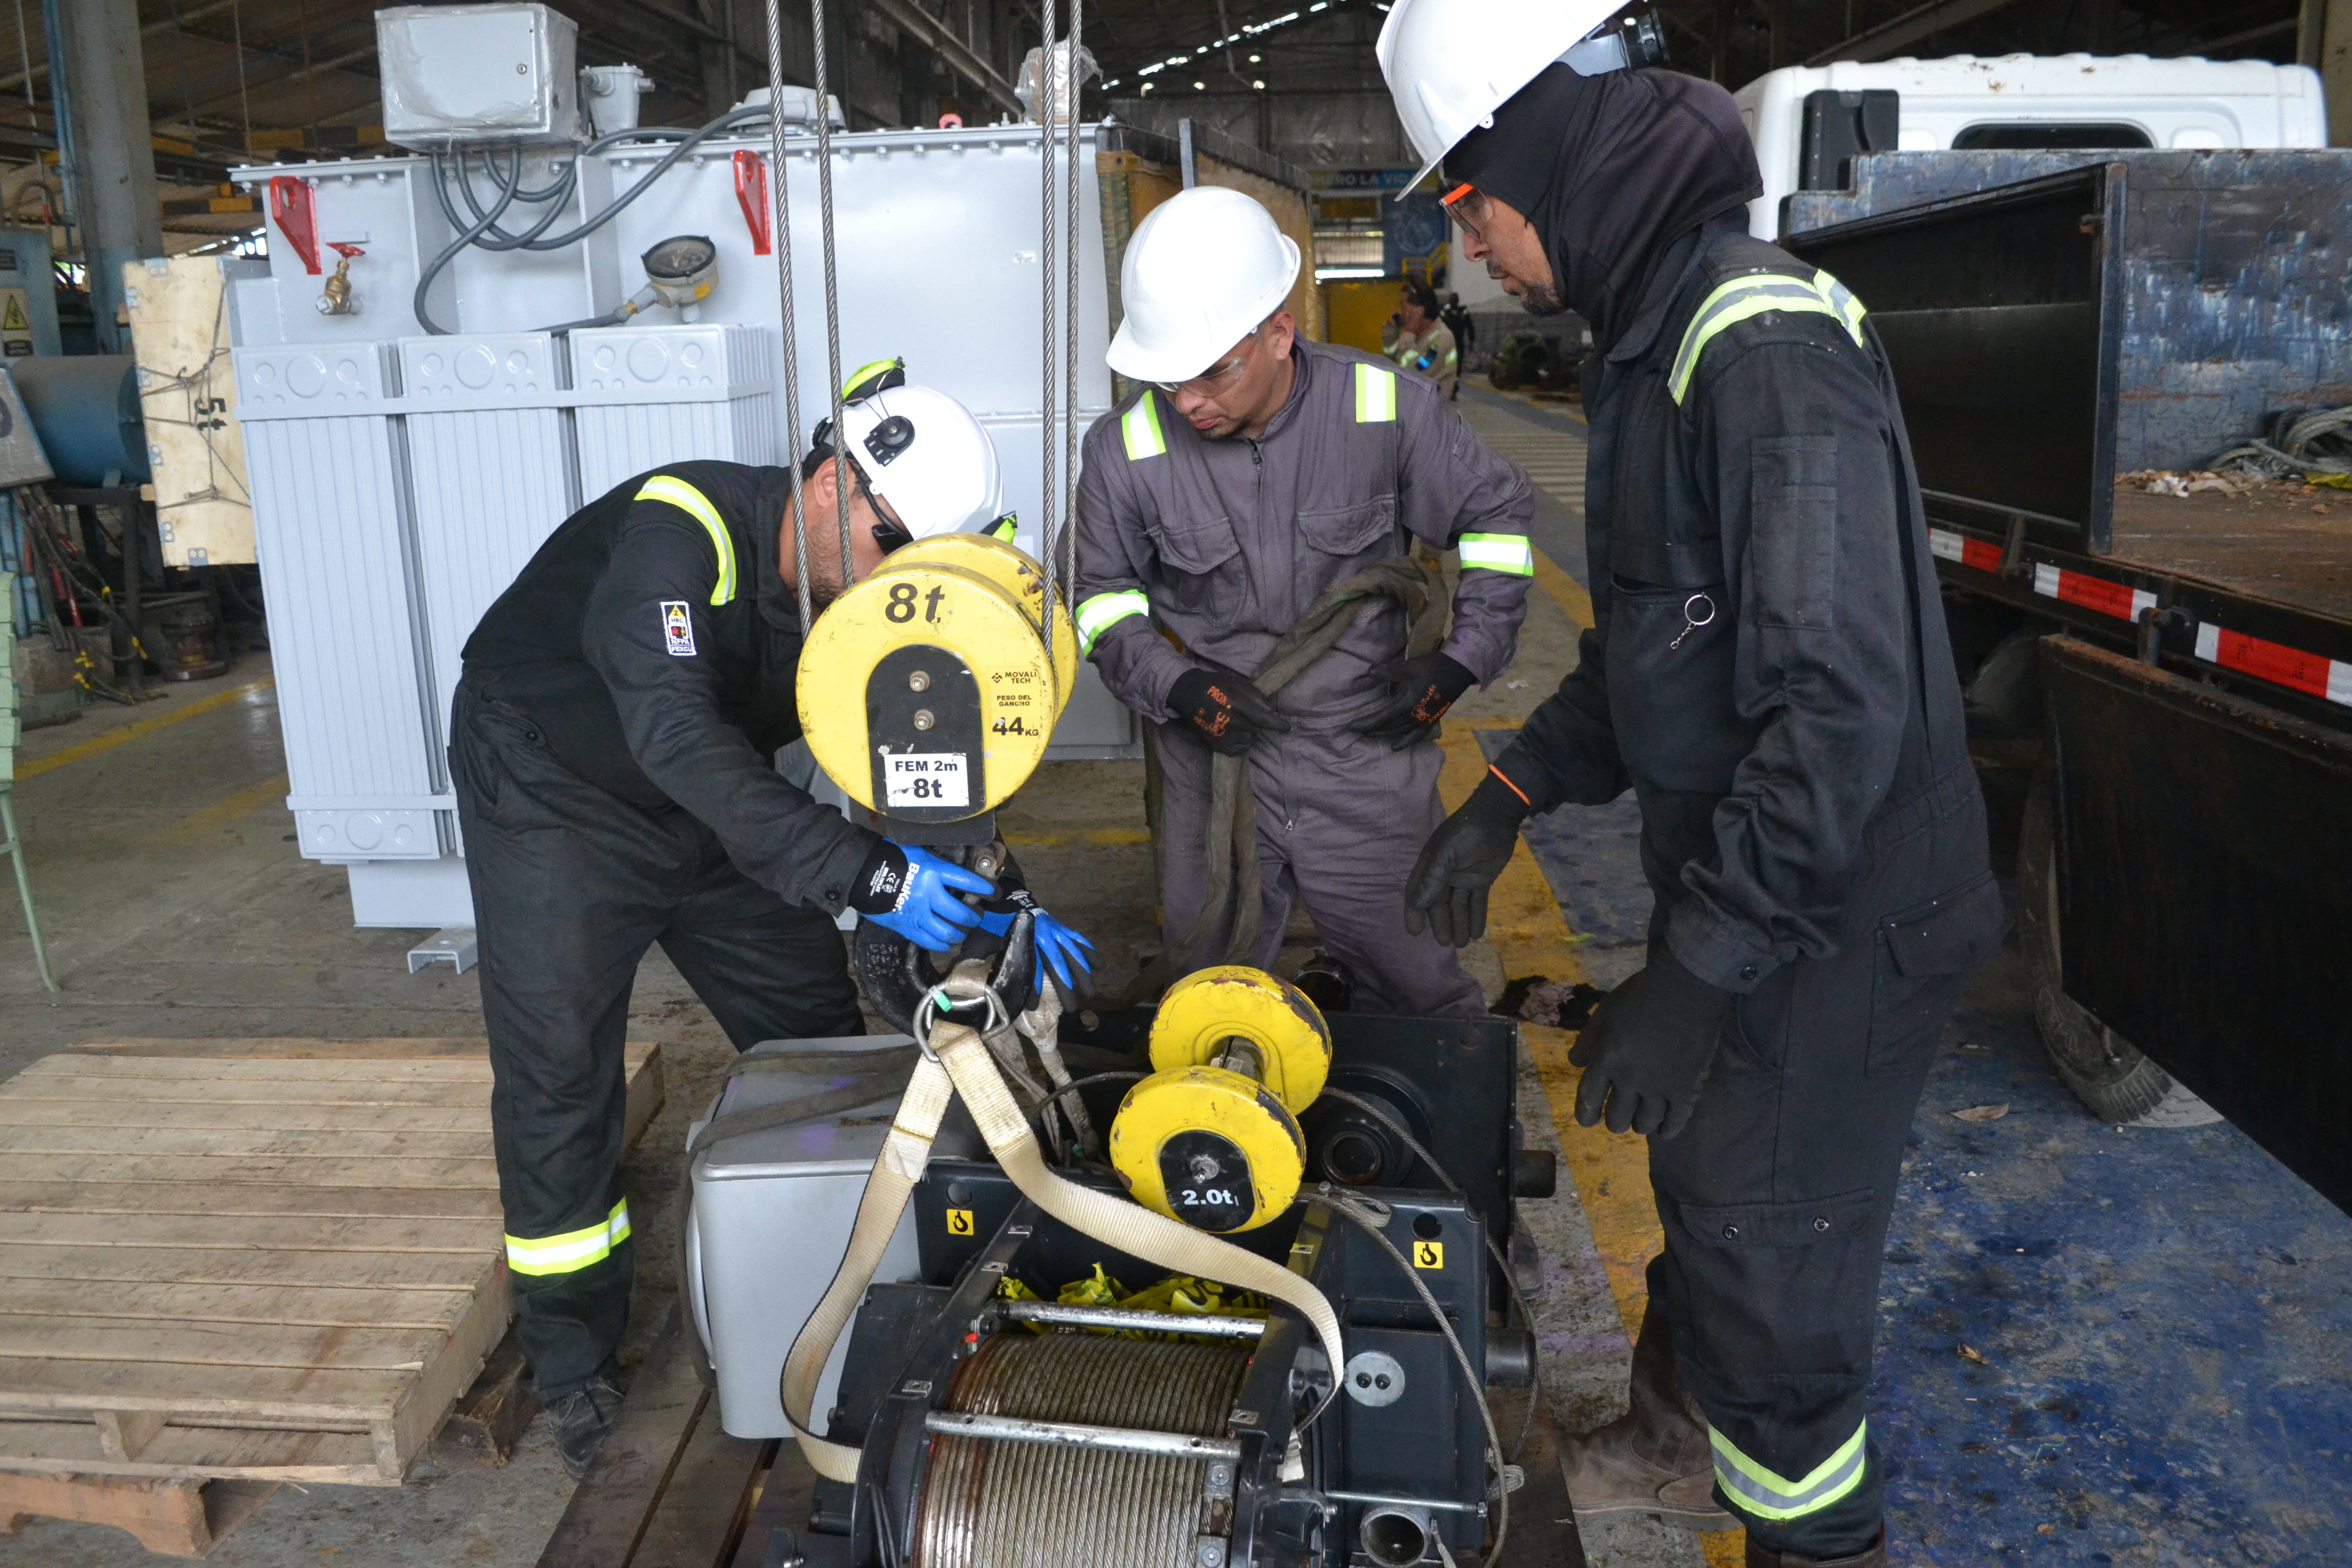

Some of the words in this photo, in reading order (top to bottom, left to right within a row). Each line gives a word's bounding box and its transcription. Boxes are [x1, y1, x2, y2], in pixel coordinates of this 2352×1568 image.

[1313, 173, 1356, 186] MERO
[1359, 173, 1379, 185] LA
[885, 582, 945, 624] 8t
[895, 761, 928, 772] FEM
[934, 760, 958, 771] 2m
[913, 778, 943, 798] 8t
[1182, 1189, 1233, 1205] 2.0t
